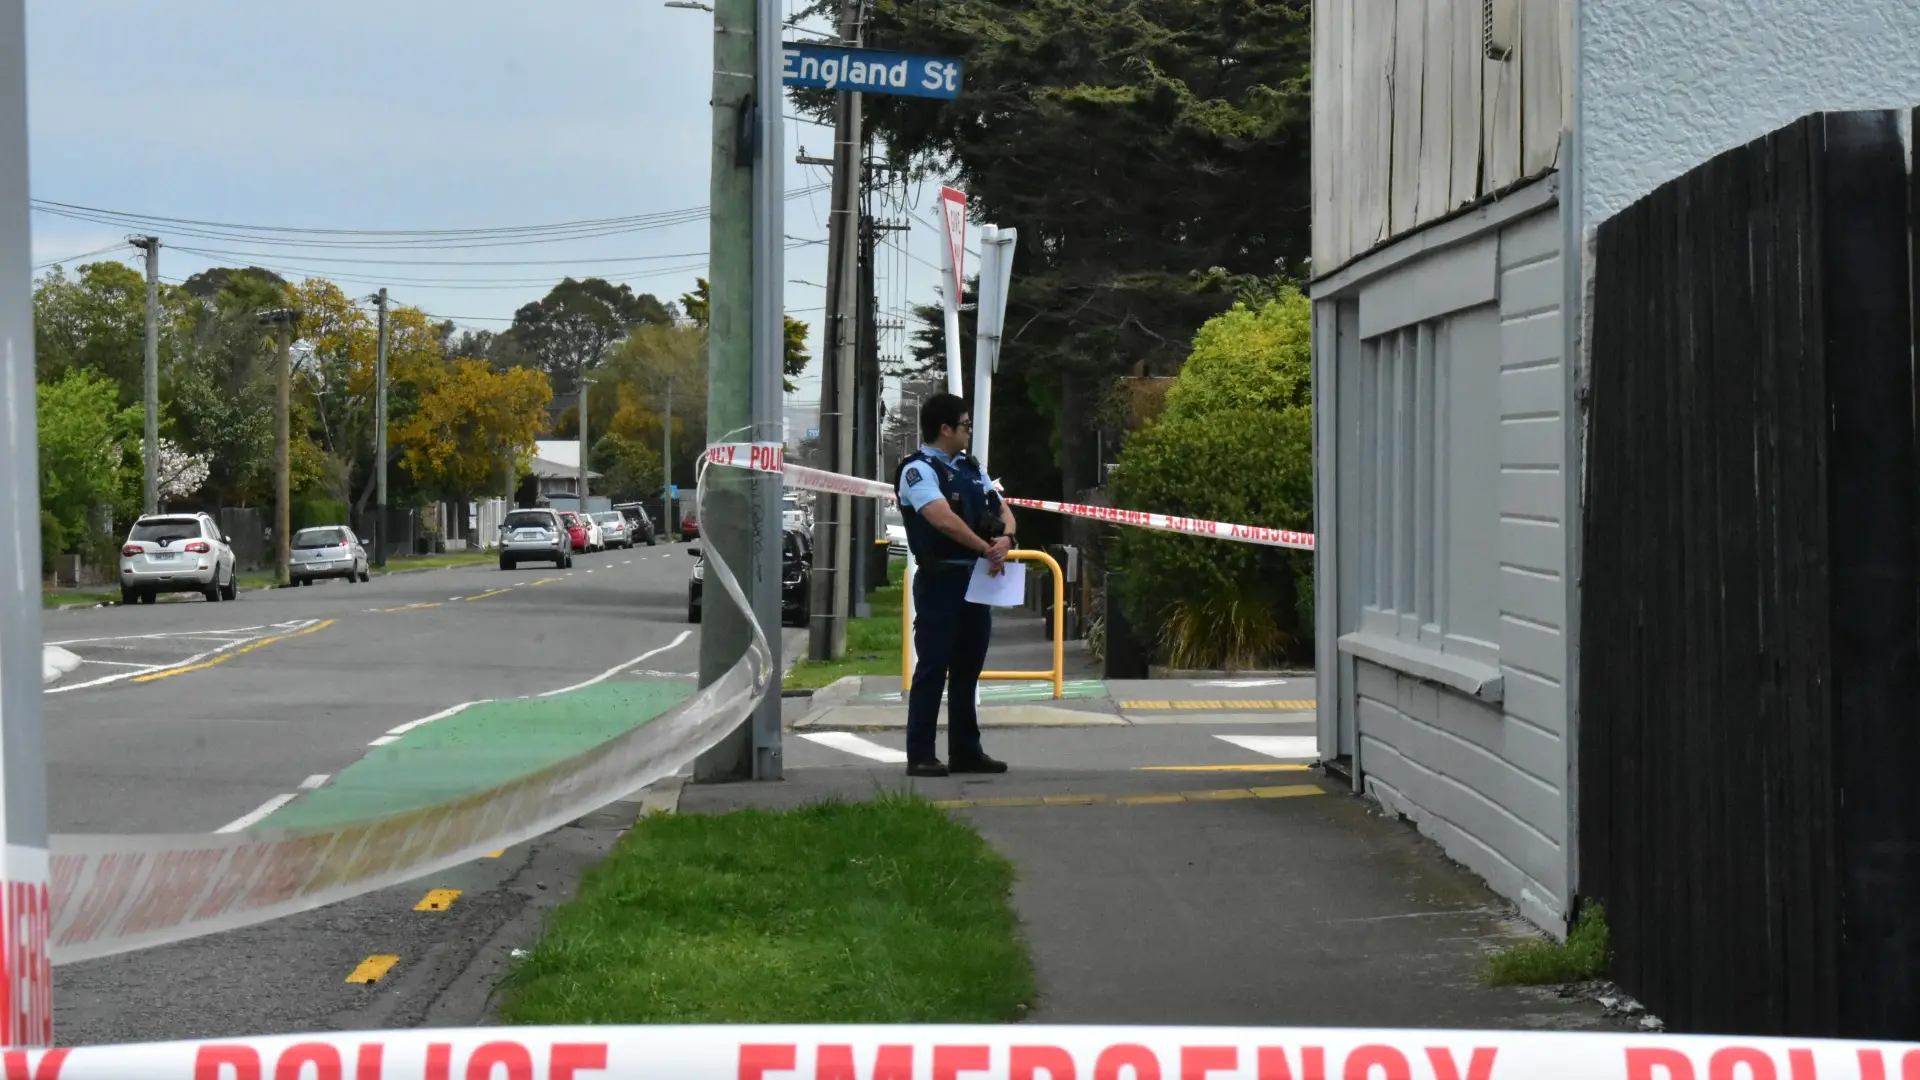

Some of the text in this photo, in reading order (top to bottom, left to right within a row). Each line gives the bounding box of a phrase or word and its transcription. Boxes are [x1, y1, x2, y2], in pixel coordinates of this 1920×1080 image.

[782, 50, 958, 91] England St
[1231, 523, 1315, 546] MERGENCY
